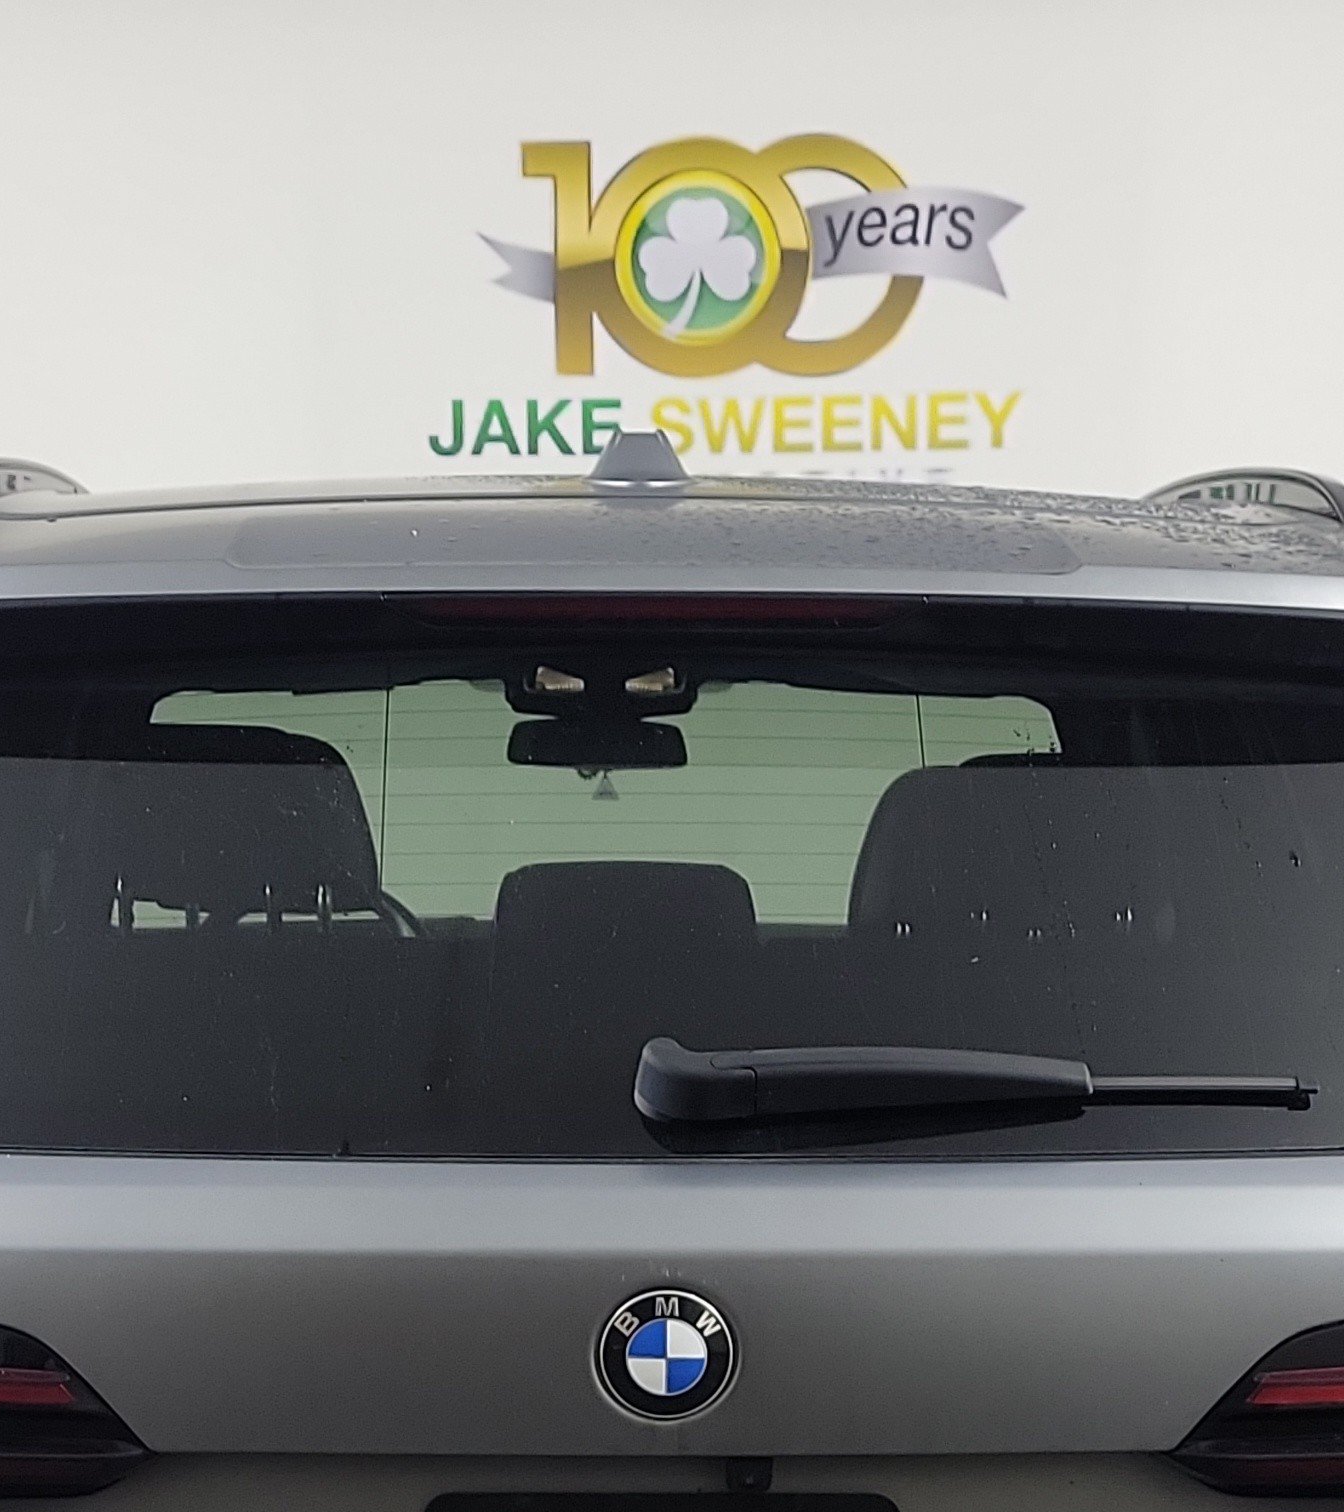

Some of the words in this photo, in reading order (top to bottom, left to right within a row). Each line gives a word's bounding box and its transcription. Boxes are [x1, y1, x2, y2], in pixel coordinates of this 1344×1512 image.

[822, 203, 976, 266] years
[428, 398, 622, 456] JAKE
[650, 391, 1022, 455] SWEENEY
[614, 1296, 722, 1338] BMW
